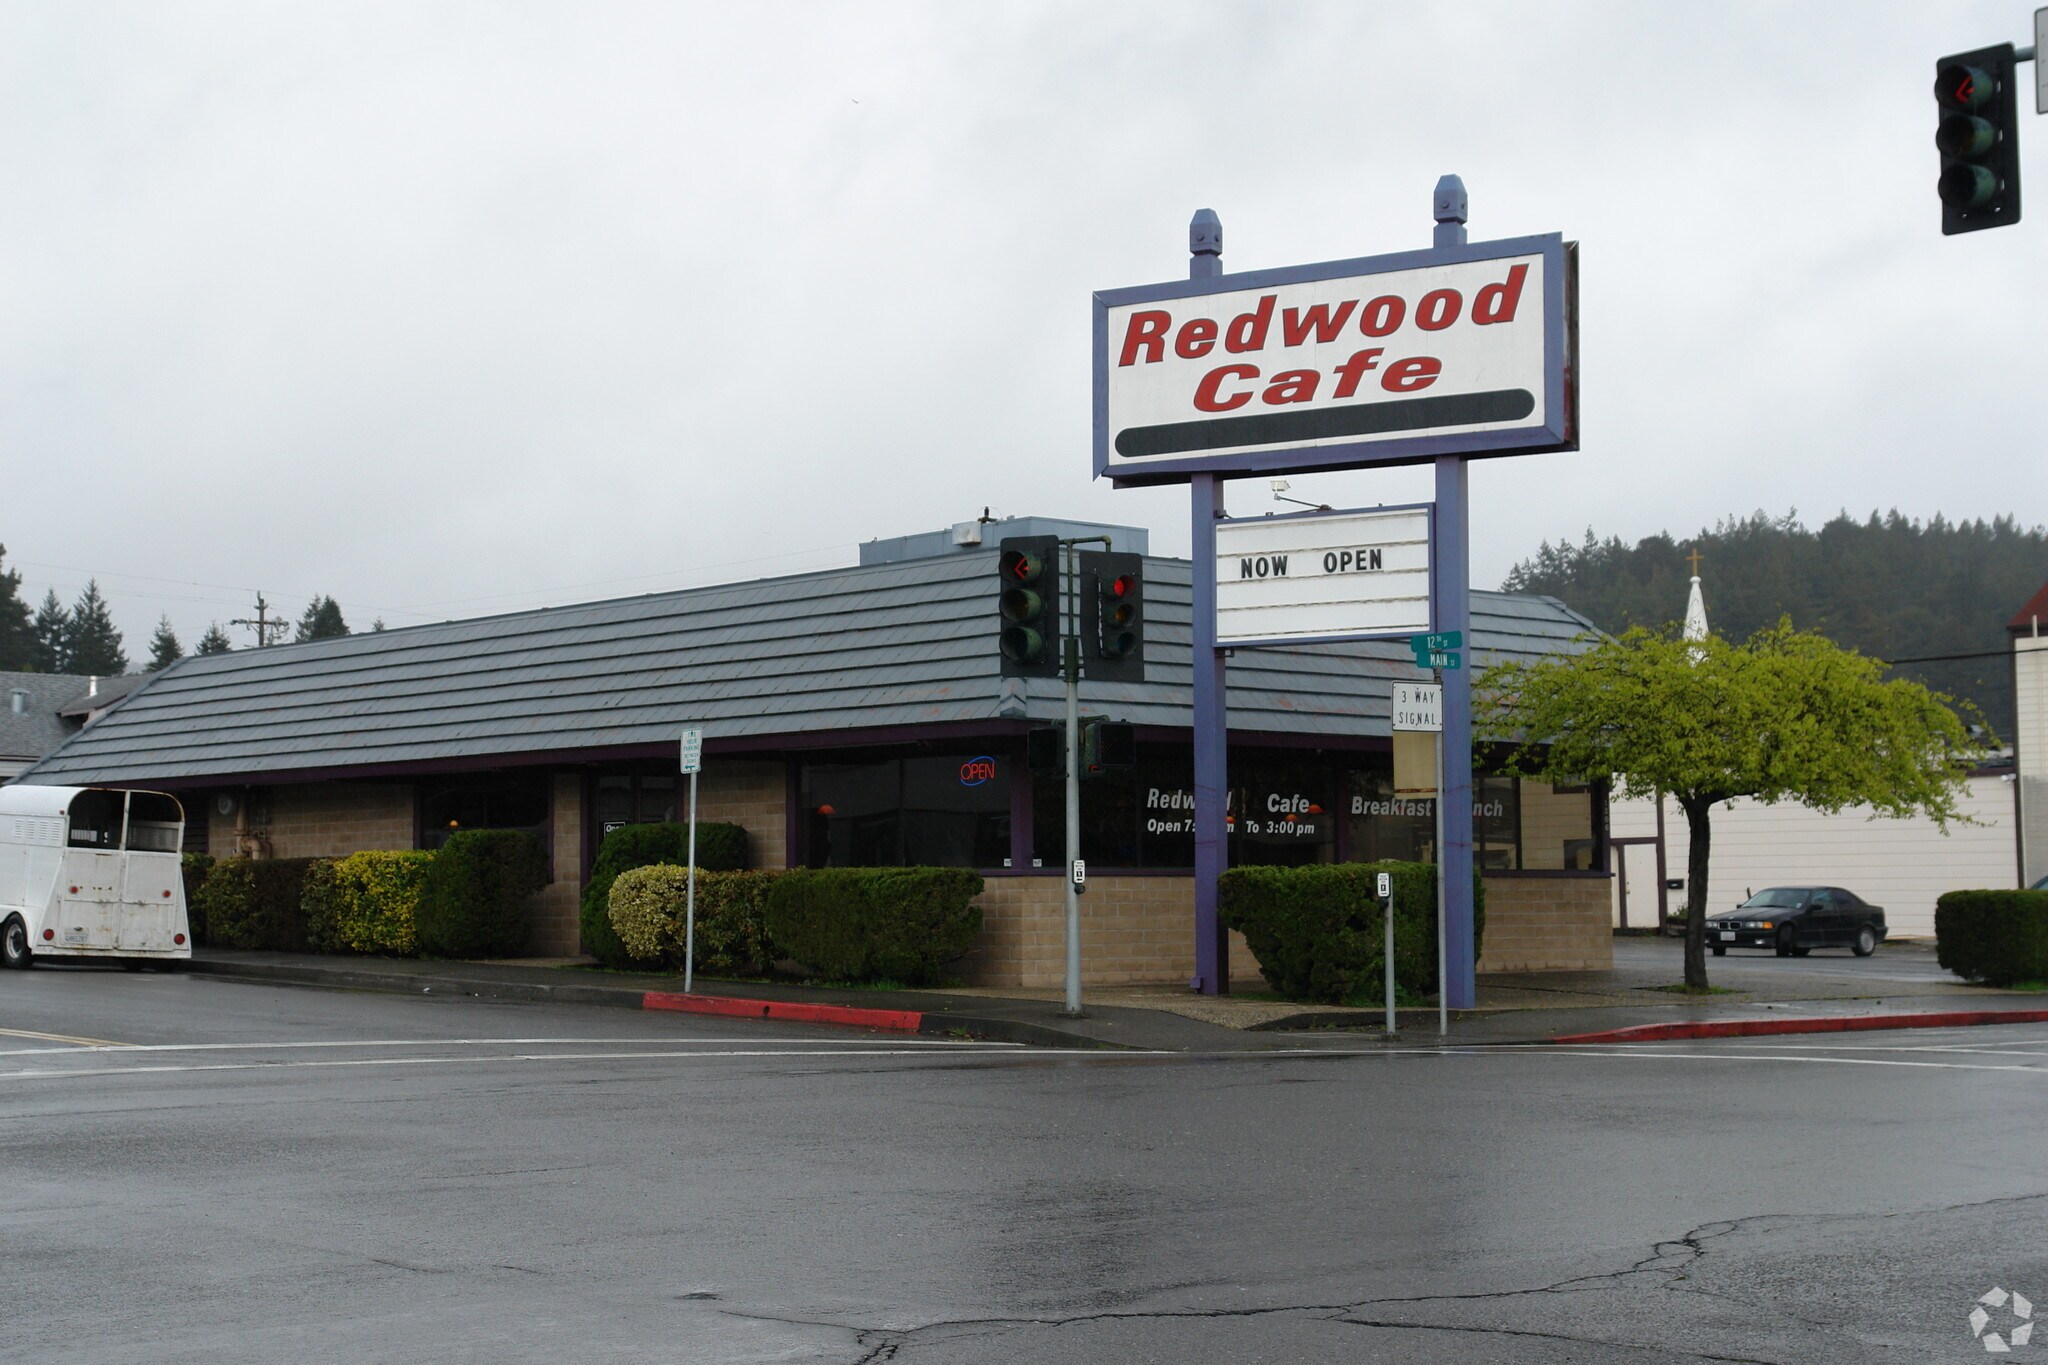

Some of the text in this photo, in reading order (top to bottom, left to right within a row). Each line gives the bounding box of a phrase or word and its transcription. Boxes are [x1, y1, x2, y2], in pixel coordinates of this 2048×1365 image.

[1118, 263, 1530, 367] Redwood
[1193, 347, 1442, 412] Cafe
[1241, 548, 1382, 578] NOW OPEN
[1430, 653, 1448, 667] MAIN
[1401, 691, 1435, 704] 3 WAY
[1399, 712, 1436, 725] SIGNAL
[960, 763, 995, 780] OPEN
[1147, 788, 1310, 813] Redw Cafe
[1351, 795, 1432, 817] Breakfast
[1147, 818, 1181, 834] Open
[1246, 820, 1260, 833] To
[1266, 821, 1294, 834] 3:00
[1296, 823, 1315, 836] pm
